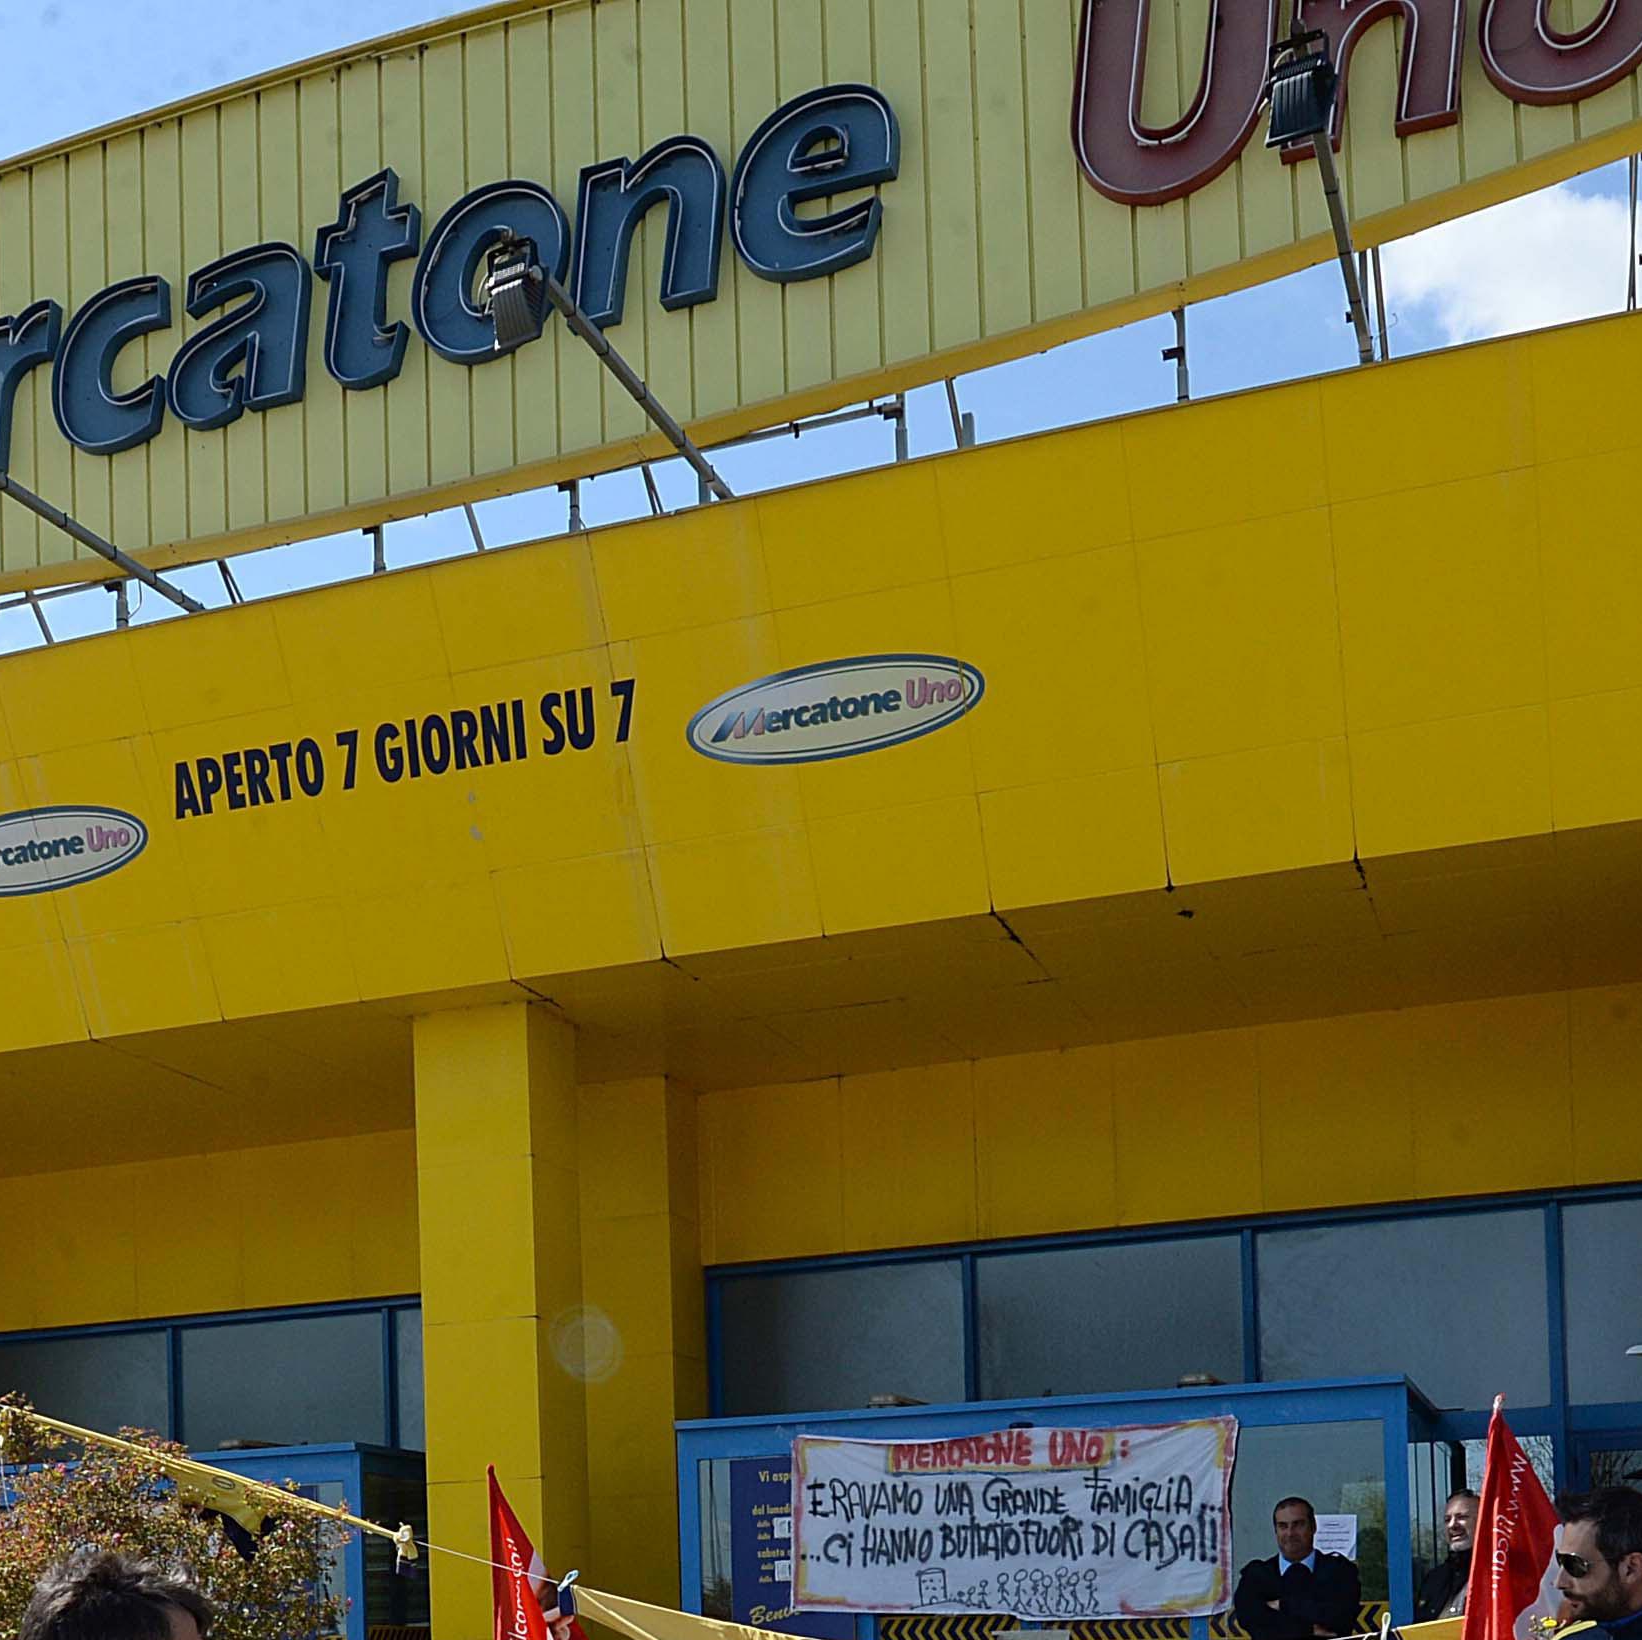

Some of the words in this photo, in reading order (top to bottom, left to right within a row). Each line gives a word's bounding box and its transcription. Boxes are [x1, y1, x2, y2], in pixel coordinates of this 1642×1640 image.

[711, 689, 902, 743] Mercatone
[906, 677, 963, 708] Uno
[175, 737, 325, 820] APERTO
[336, 729, 359, 790] 7
[374, 699, 527, 783] GIORNI
[540, 686, 596, 755] SU
[610, 678, 635, 743] 7
[86, 826, 131, 852] Uno
[891, 1430, 1034, 1470] MERCATONE
[766, 1503, 791, 1514] luned
[807, 1477, 923, 1523] ERAVAMO
[936, 1482, 975, 1516] UNA
[983, 1477, 1069, 1518] GRANDE
[861, 1523, 934, 1567] HANNO
[939, 1516, 1020, 1561] BUTTATO
[1092, 1522, 1115, 1557] DI
